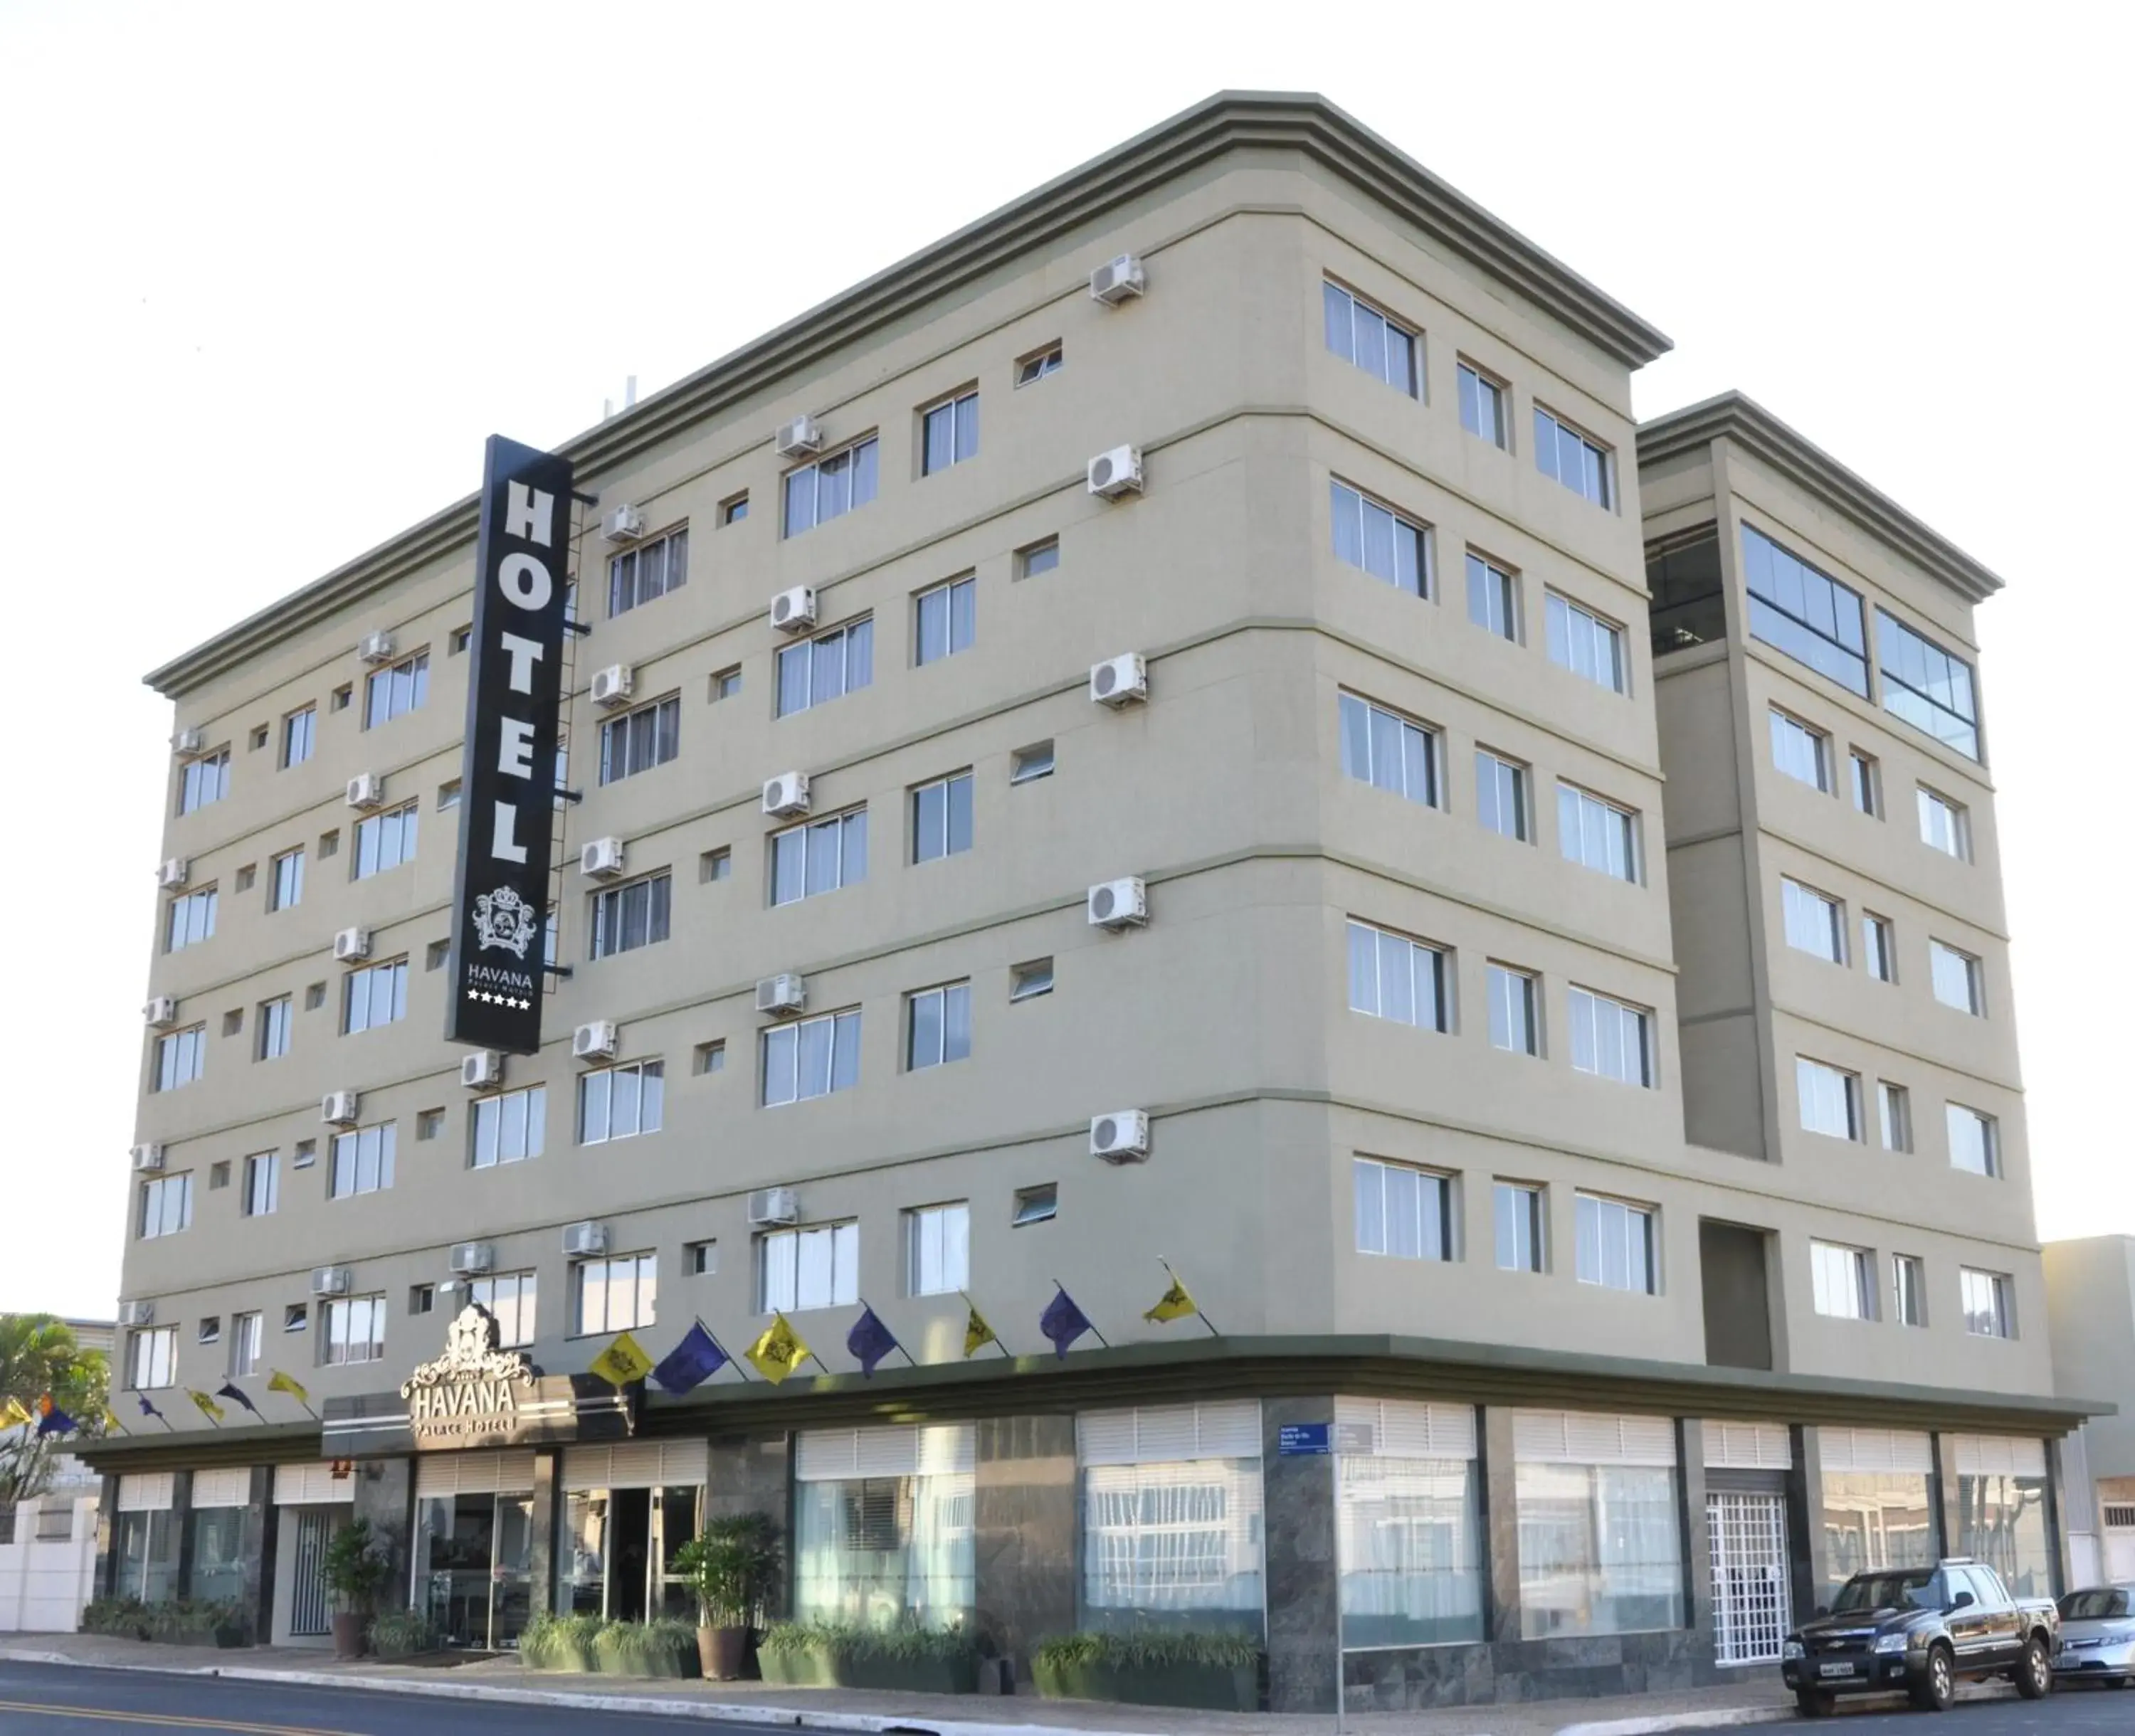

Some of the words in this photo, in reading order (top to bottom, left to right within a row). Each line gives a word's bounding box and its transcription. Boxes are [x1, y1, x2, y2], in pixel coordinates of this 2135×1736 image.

[491, 479, 554, 864] HOTEL
[468, 963, 532, 989] HAVANA
[416, 1379, 515, 1419] HAVANA
[416, 1423, 462, 1438] PALACE
